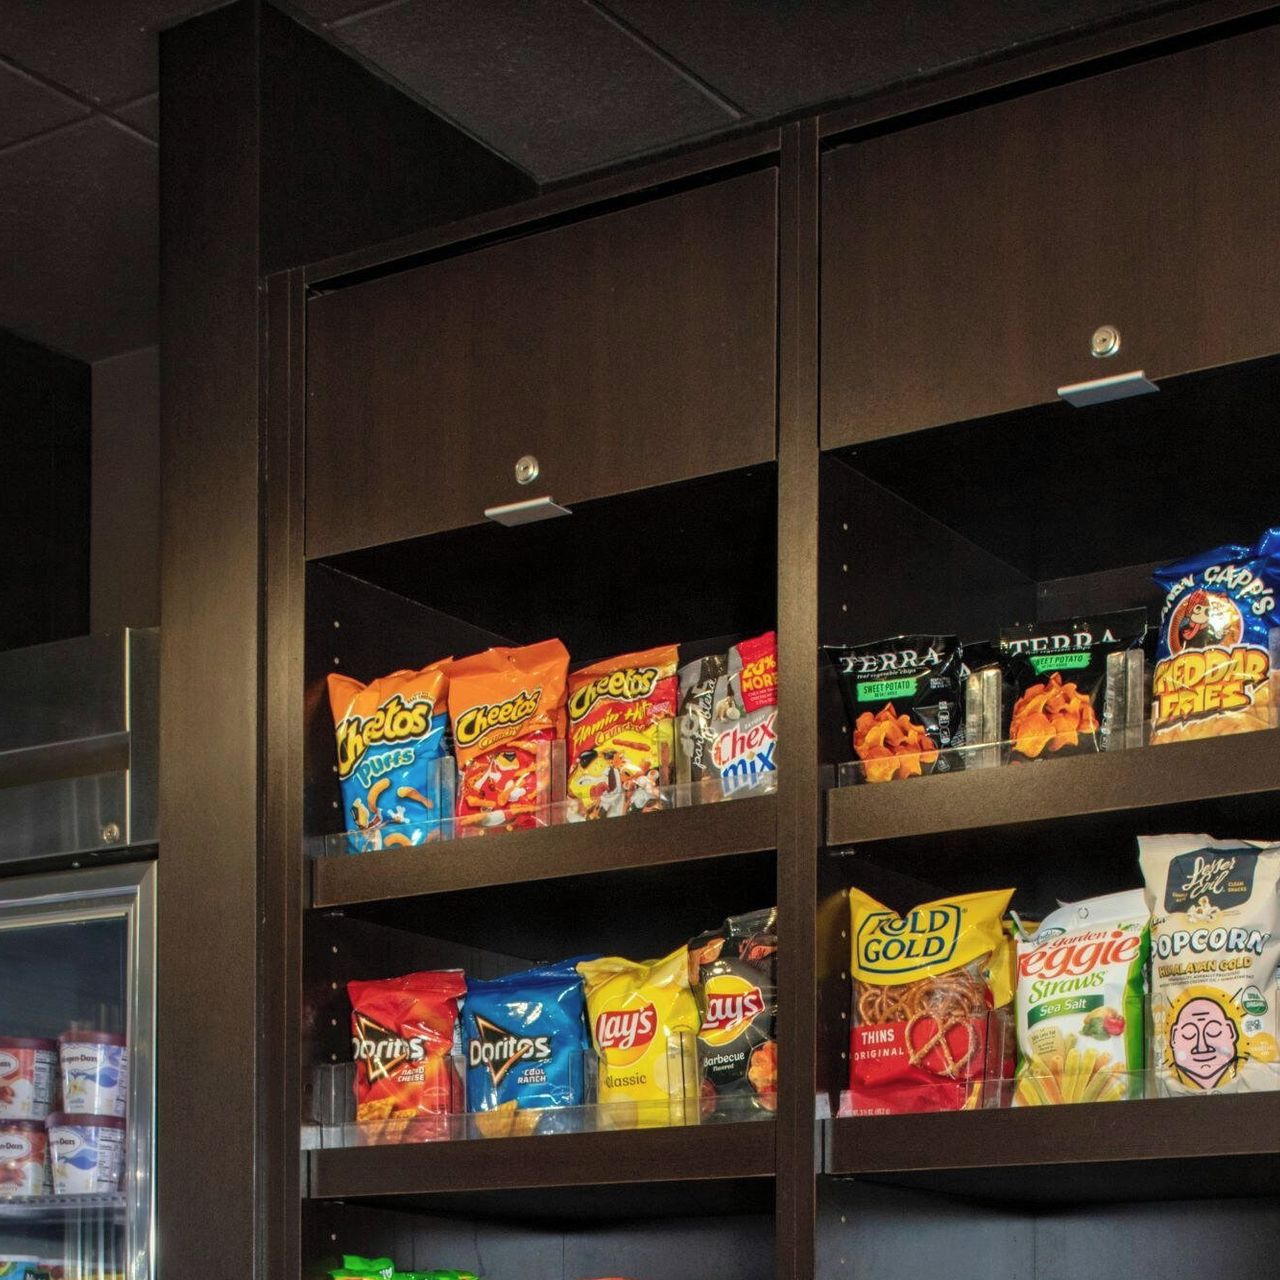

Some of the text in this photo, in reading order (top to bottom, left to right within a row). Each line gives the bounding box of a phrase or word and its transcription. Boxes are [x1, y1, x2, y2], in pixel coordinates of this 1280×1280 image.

[1204, 565, 1275, 615] CAPP'S
[839, 647, 944, 673] TERRA
[569, 667, 658, 722] Cheetos
[863, 683, 884, 694] SWEET
[885, 680, 910, 692] POTATO
[456, 689, 542, 747] Cheetos
[337, 695, 432, 778] Cheetos
[713, 713, 778, 768] Chex
[863, 936, 945, 963] GOLD
[1219, 956, 1253, 971] GOLD
[1029, 972, 1105, 1004] Straws
[1040, 999, 1087, 1017] Sea Salt
[596, 1007, 653, 1049] Lay's
[861, 1029, 895, 1045] THINS
[352, 1038, 425, 1061] Doritos
[470, 1037, 551, 1066] Doritos
[704, 1052, 745, 1067] Barbecue
[854, 1047, 905, 1061] ORIGINAL
[517, 1075, 546, 1084] RANCH
[605, 1074, 647, 1088] Classic
